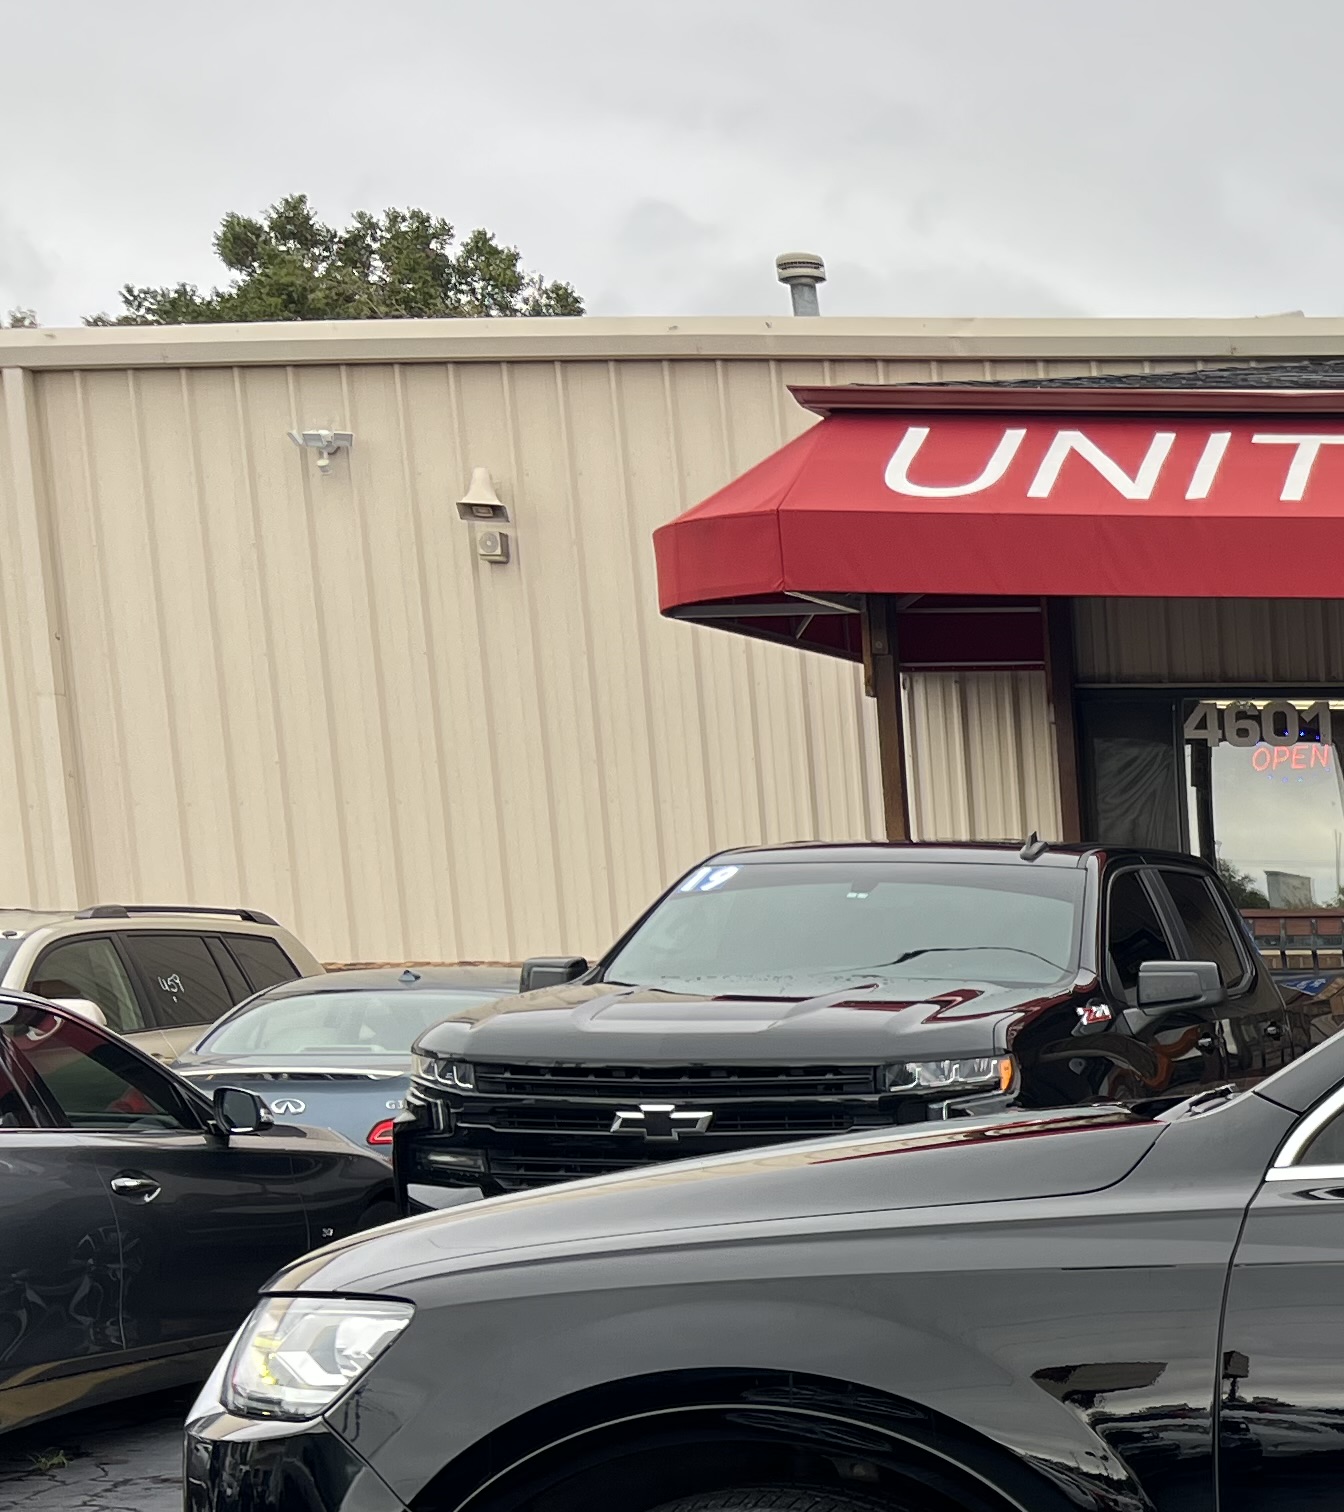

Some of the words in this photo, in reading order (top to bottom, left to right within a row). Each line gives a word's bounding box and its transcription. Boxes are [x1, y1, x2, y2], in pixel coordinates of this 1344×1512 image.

[1183, 700, 1332, 748] 4601
[1252, 744, 1330, 772] OPEN
[680, 865, 739, 892] 19
